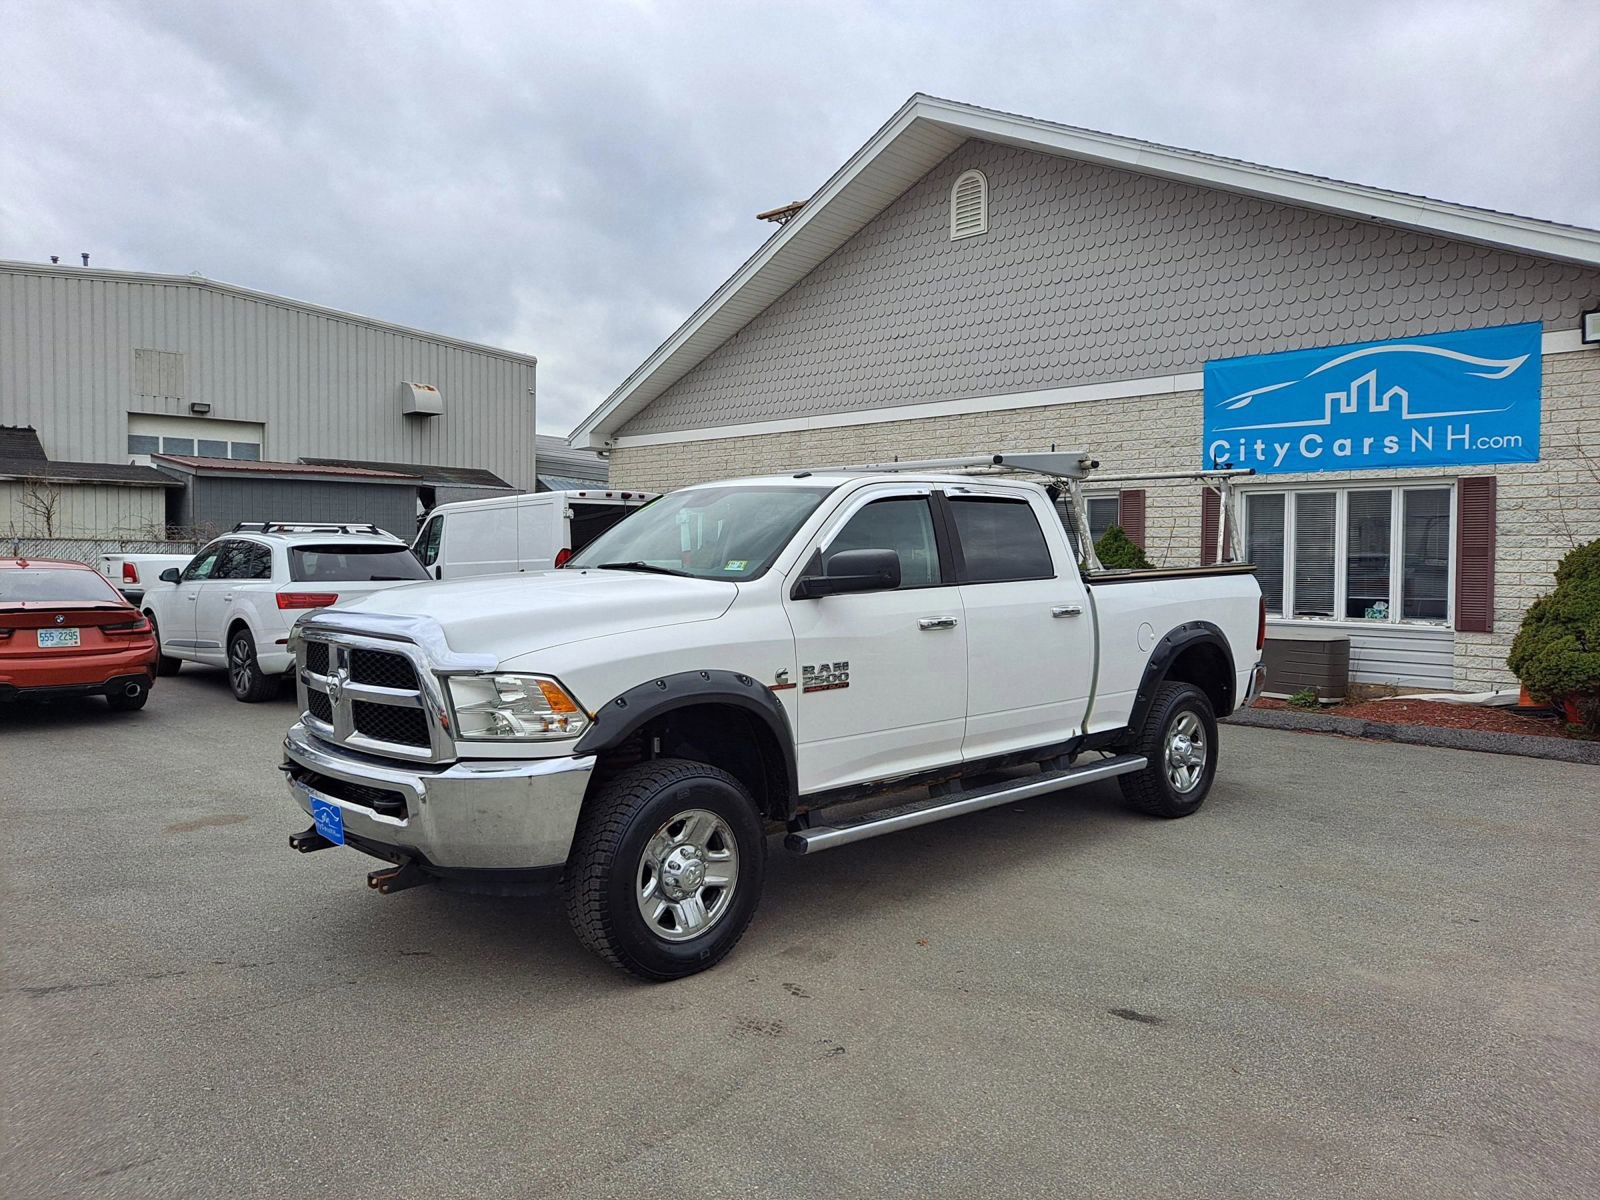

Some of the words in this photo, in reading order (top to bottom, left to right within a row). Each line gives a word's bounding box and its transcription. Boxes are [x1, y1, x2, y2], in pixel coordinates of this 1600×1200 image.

[39, 632, 55, 642] 555
[58, 631, 78, 641] 2295
[802, 672, 849, 686] 2500
